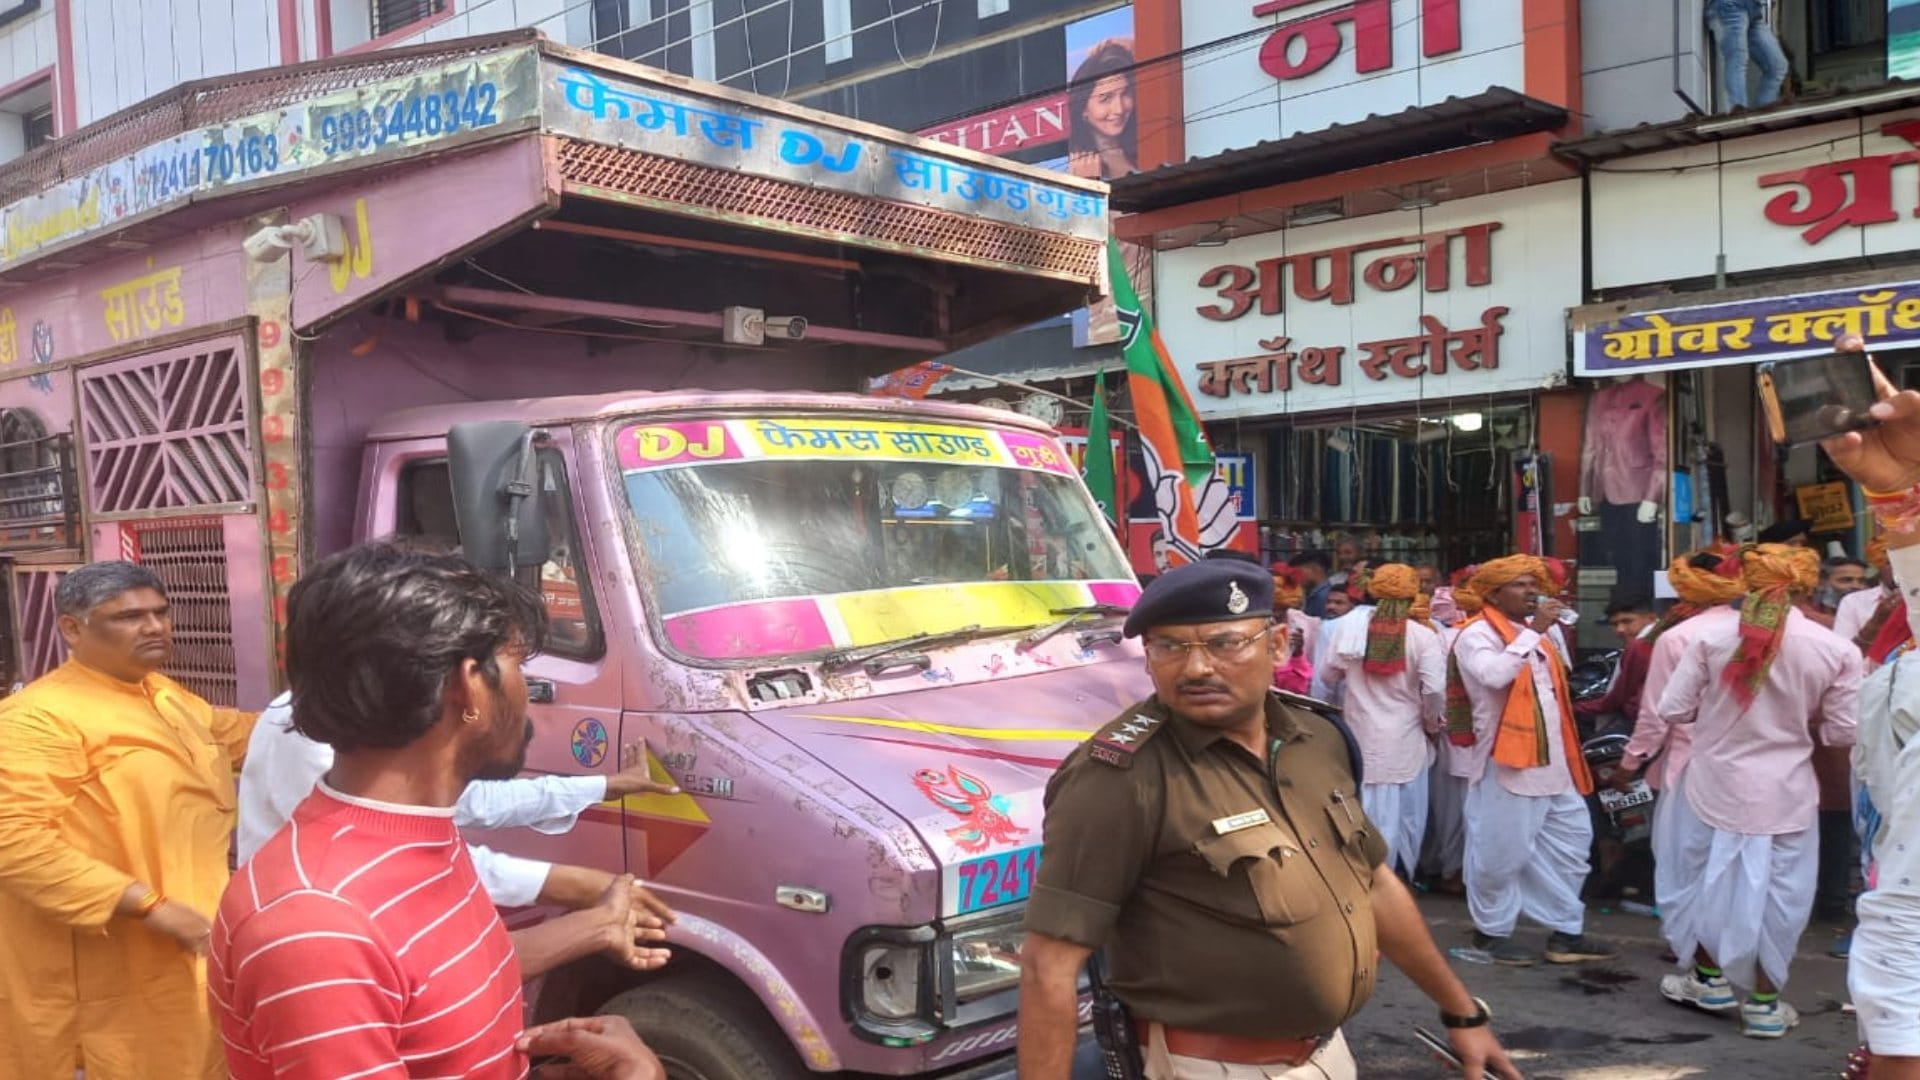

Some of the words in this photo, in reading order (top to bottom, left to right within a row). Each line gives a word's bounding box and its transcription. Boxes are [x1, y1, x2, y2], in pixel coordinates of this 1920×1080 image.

[321, 81, 497, 156] 9993448342
[557, 66, 763, 150] फेमस
[779, 130, 862, 173] DJ
[100, 256, 184, 342] साउंड
[1196, 221, 1503, 322] अपना
[1196, 337, 1346, 398] क्लॉथ
[1358, 306, 1509, 381] स्टोर्स
[1602, 313, 1755, 360] ग्रोवर
[634, 425, 725, 461] DJ
[756, 420, 880, 451] फेमस
[958, 848, 1037, 909] 7241
